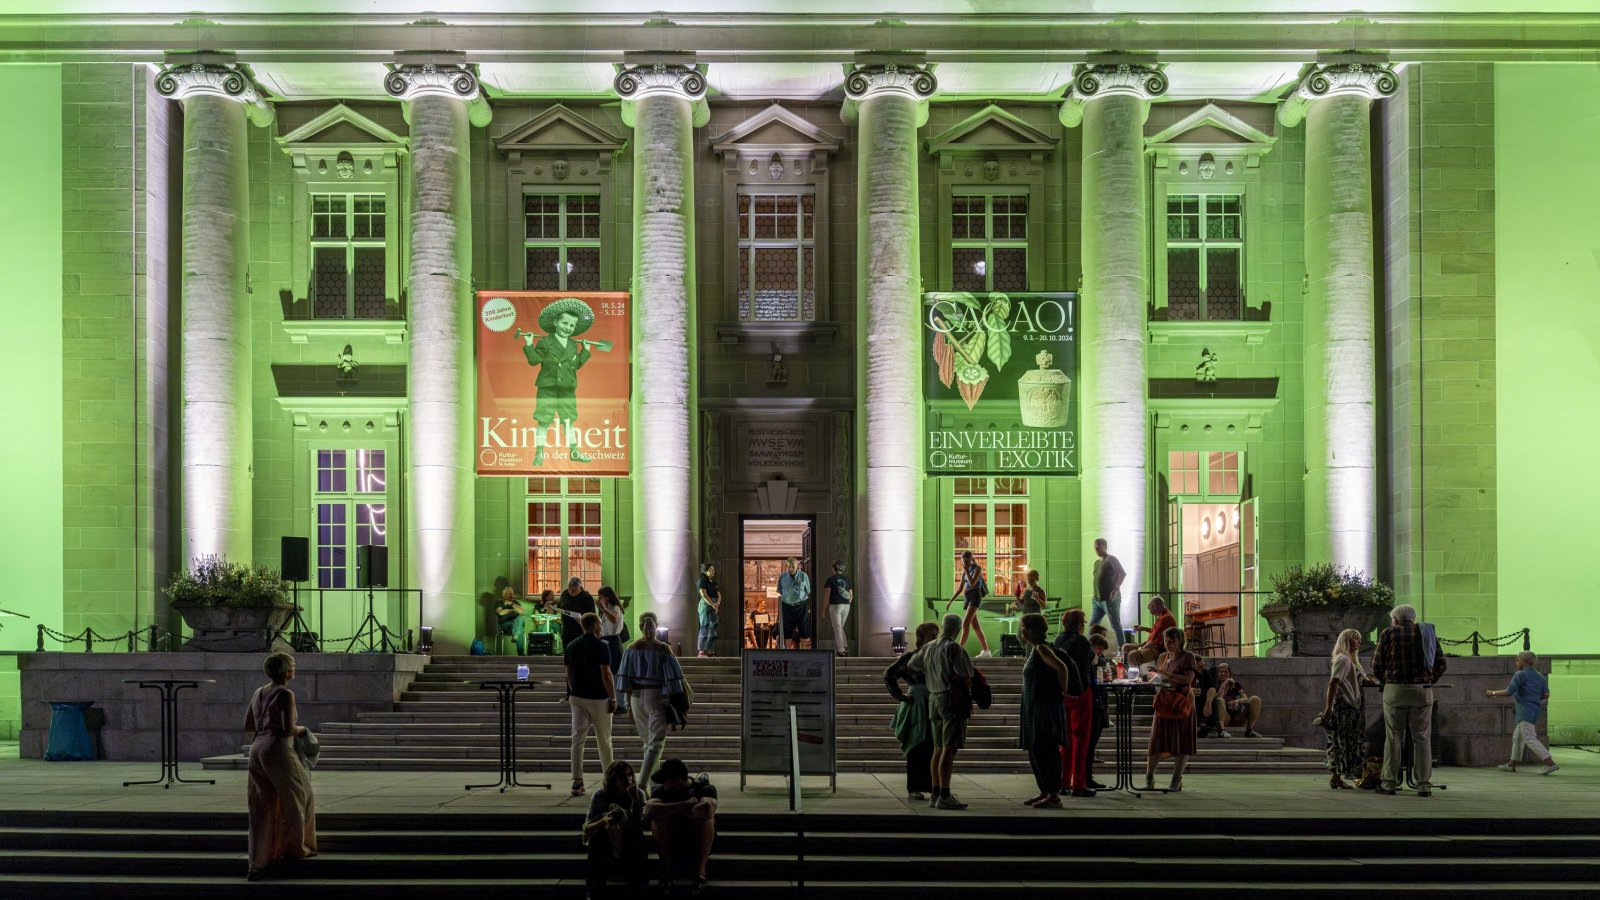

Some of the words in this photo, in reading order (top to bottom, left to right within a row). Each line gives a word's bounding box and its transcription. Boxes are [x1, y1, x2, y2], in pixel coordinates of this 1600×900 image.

[485, 311, 514, 322] Kinderfest
[496, 306, 511, 314] Jahre
[929, 300, 1073, 333] CACAO!
[480, 417, 627, 449] Kindheit
[929, 431, 1075, 449] EINVERLEIBTE
[540, 450, 550, 460] in
[552, 450, 568, 460] der
[571, 450, 626, 460] Ostschweiz
[999, 450, 1075, 468] EXOTIK
